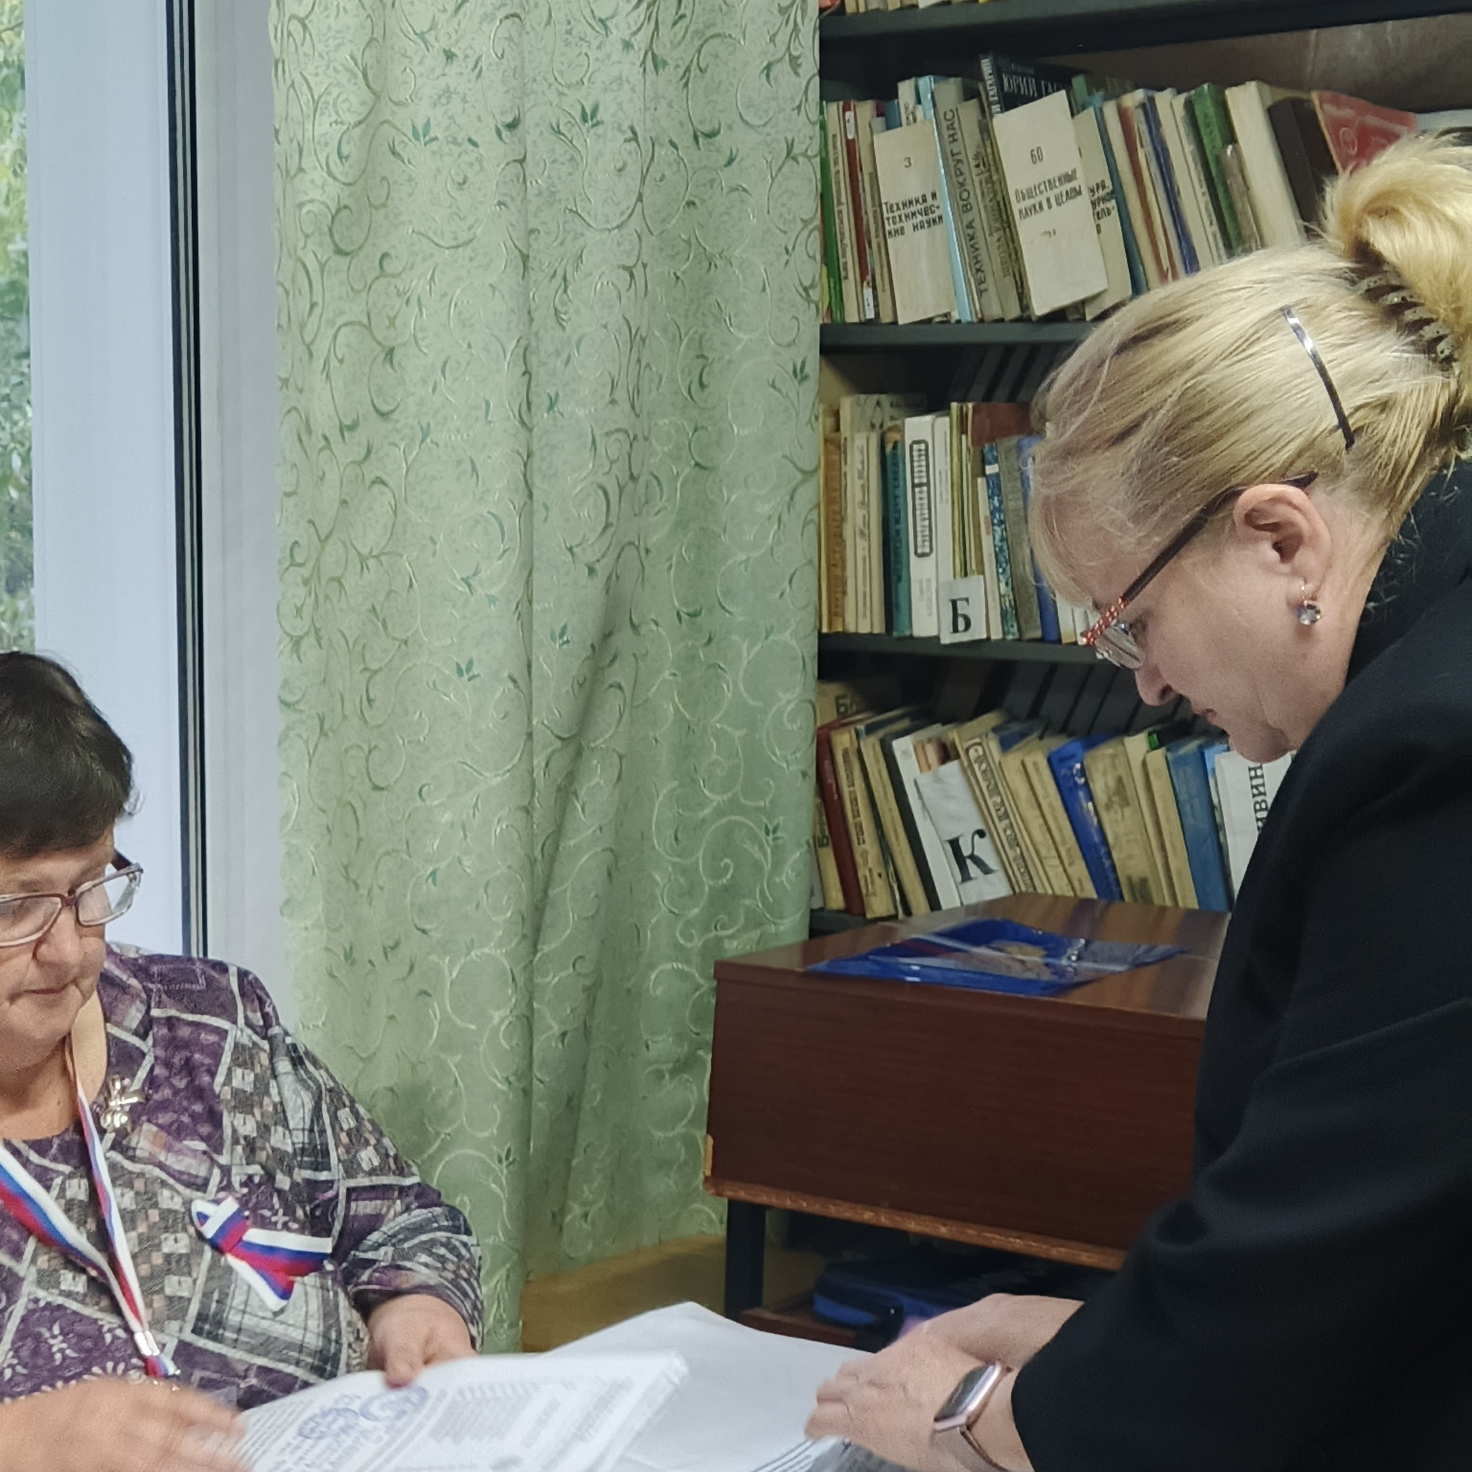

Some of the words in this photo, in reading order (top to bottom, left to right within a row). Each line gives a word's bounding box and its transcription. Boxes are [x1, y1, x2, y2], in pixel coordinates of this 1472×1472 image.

[943, 107, 961, 143] НАС
[950, 147, 973, 214] ВОКРУГ
[965, 218, 988, 297] ТЕХНИКА
[949, 597, 972, 635] Б
[944, 828, 999, 885] К
